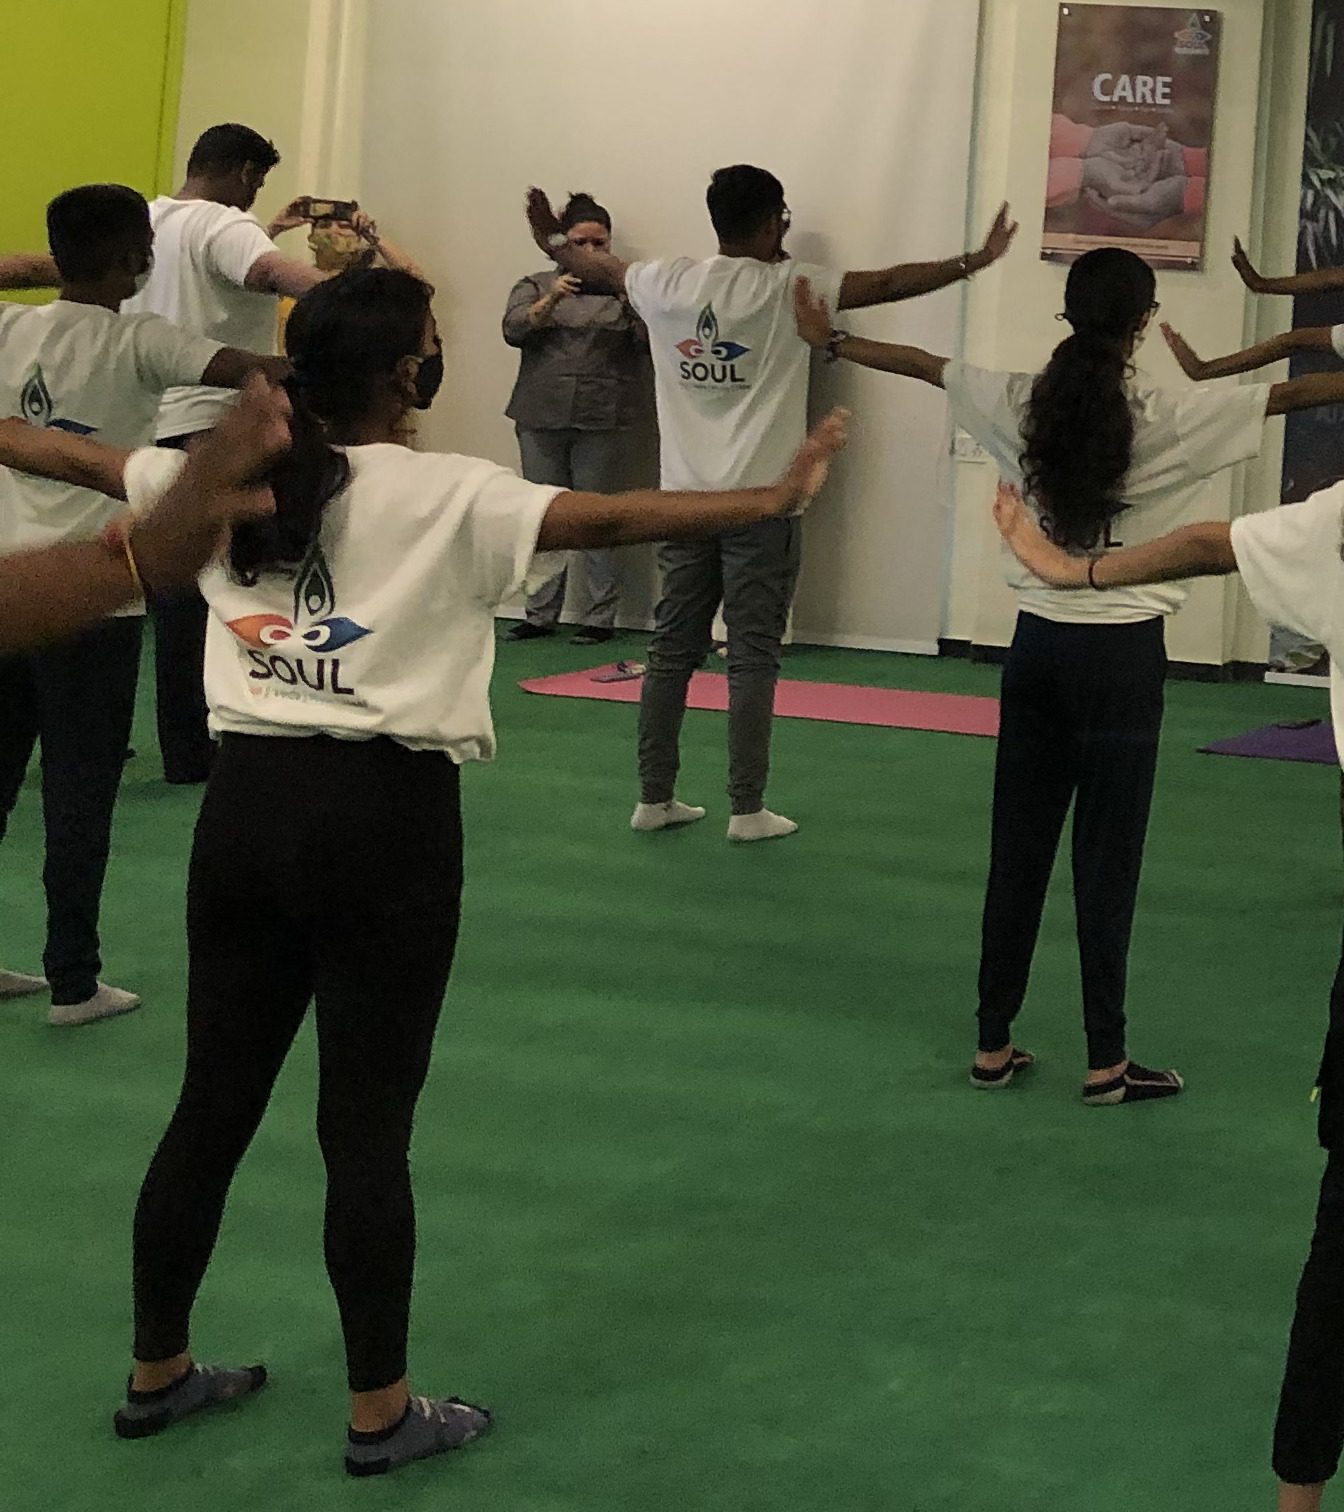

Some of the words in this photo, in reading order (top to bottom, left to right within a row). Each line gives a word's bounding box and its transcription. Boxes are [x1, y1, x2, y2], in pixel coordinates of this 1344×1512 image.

[1092, 73, 1173, 105] CARE
[680, 361, 745, 383] SOUL
[247, 649, 355, 695] SOUL
